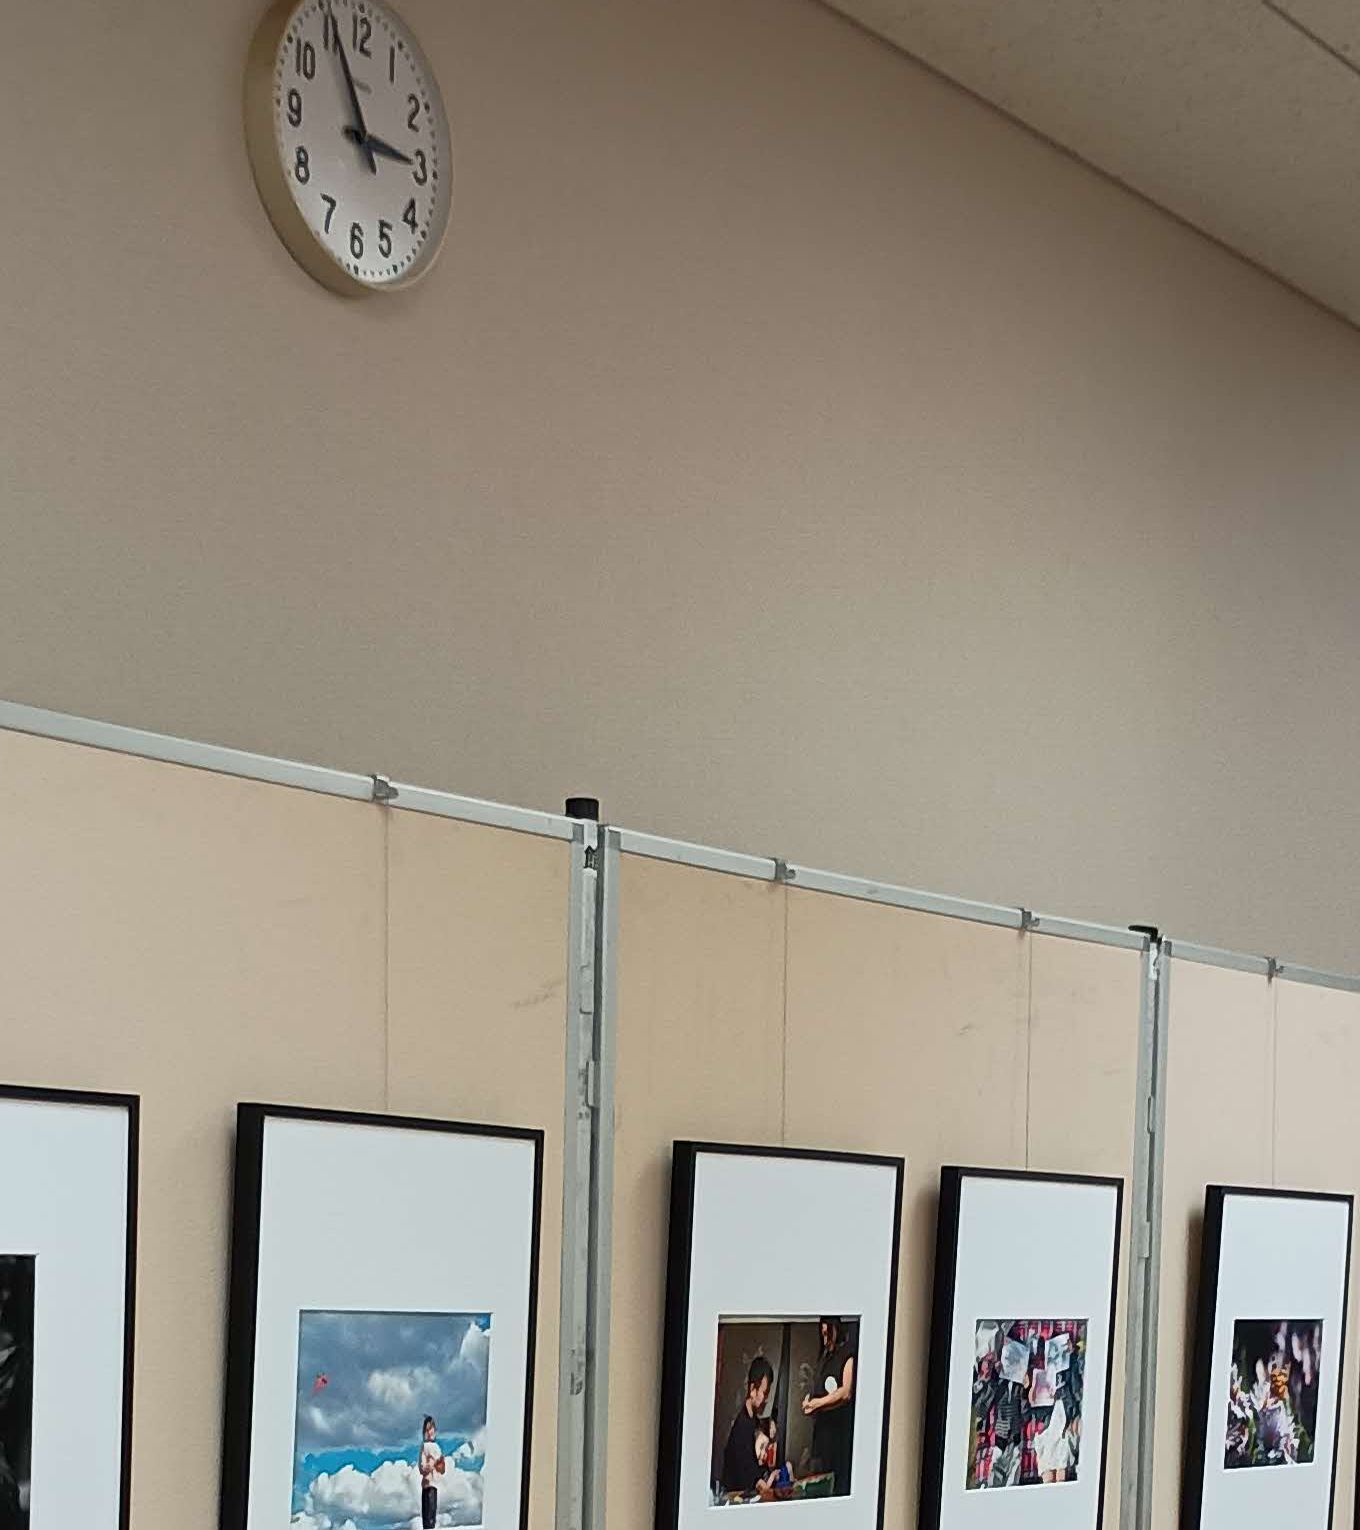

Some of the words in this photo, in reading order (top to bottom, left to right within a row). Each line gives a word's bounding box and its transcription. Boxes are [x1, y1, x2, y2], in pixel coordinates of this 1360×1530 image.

[352, 13, 372, 58] 12
[295, 38, 316, 81] 10
[389, 45, 396, 84] 1
[287, 88, 303, 128] 9
[407, 93, 420, 133] 2
[294, 145, 311, 185] 8
[412, 149, 428, 186] 3
[320, 192, 337, 234] 7
[402, 197, 418, 234] 4
[350, 222, 365, 259] 6
[378, 219, 393, 258] 5
